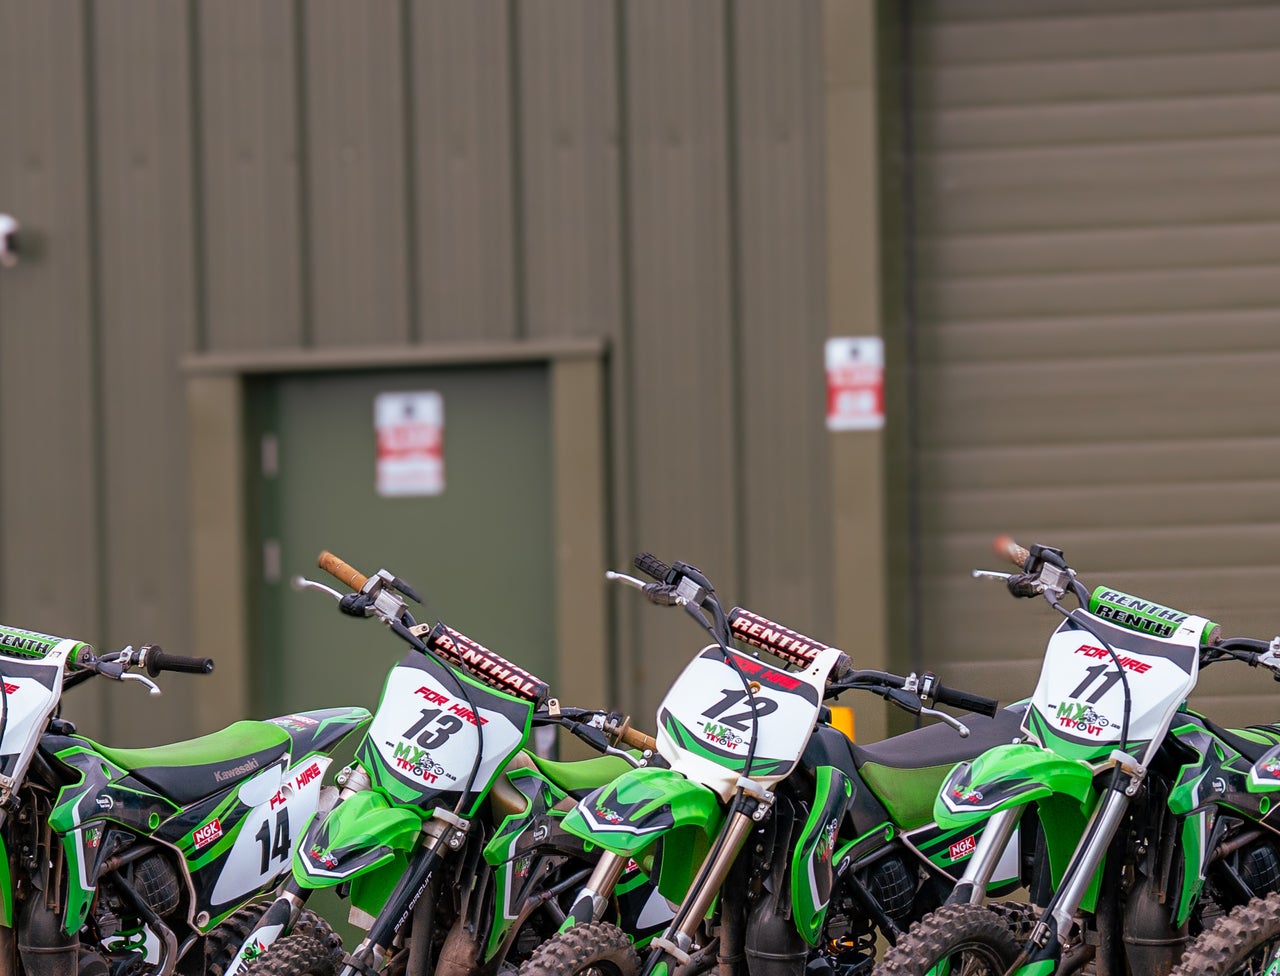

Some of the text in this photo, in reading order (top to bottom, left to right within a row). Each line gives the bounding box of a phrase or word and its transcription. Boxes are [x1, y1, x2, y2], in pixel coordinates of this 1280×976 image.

[1095, 604, 1173, 637] RENTH
[1099, 590, 1189, 624] RENTHA
[732, 616, 823, 660] RENTHA
[1074, 644, 1110, 660] FOR
[435, 634, 534, 698] RENTHAL
[1068, 664, 1128, 705] 11
[414, 686, 490, 728] FOR HIRE
[701, 688, 779, 732] 12
[1059, 717, 1104, 737] TRYOUT
[401, 708, 464, 750] 13
[213, 758, 260, 783] Kawasaki
[270, 762, 321, 811] FO HIRE
[396, 757, 438, 784] TRYOUT
[195, 821, 219, 843] NGK
[255, 807, 292, 876] 14
[951, 840, 973, 855] NGK
[393, 871, 433, 933] PRO CIRCUIT
